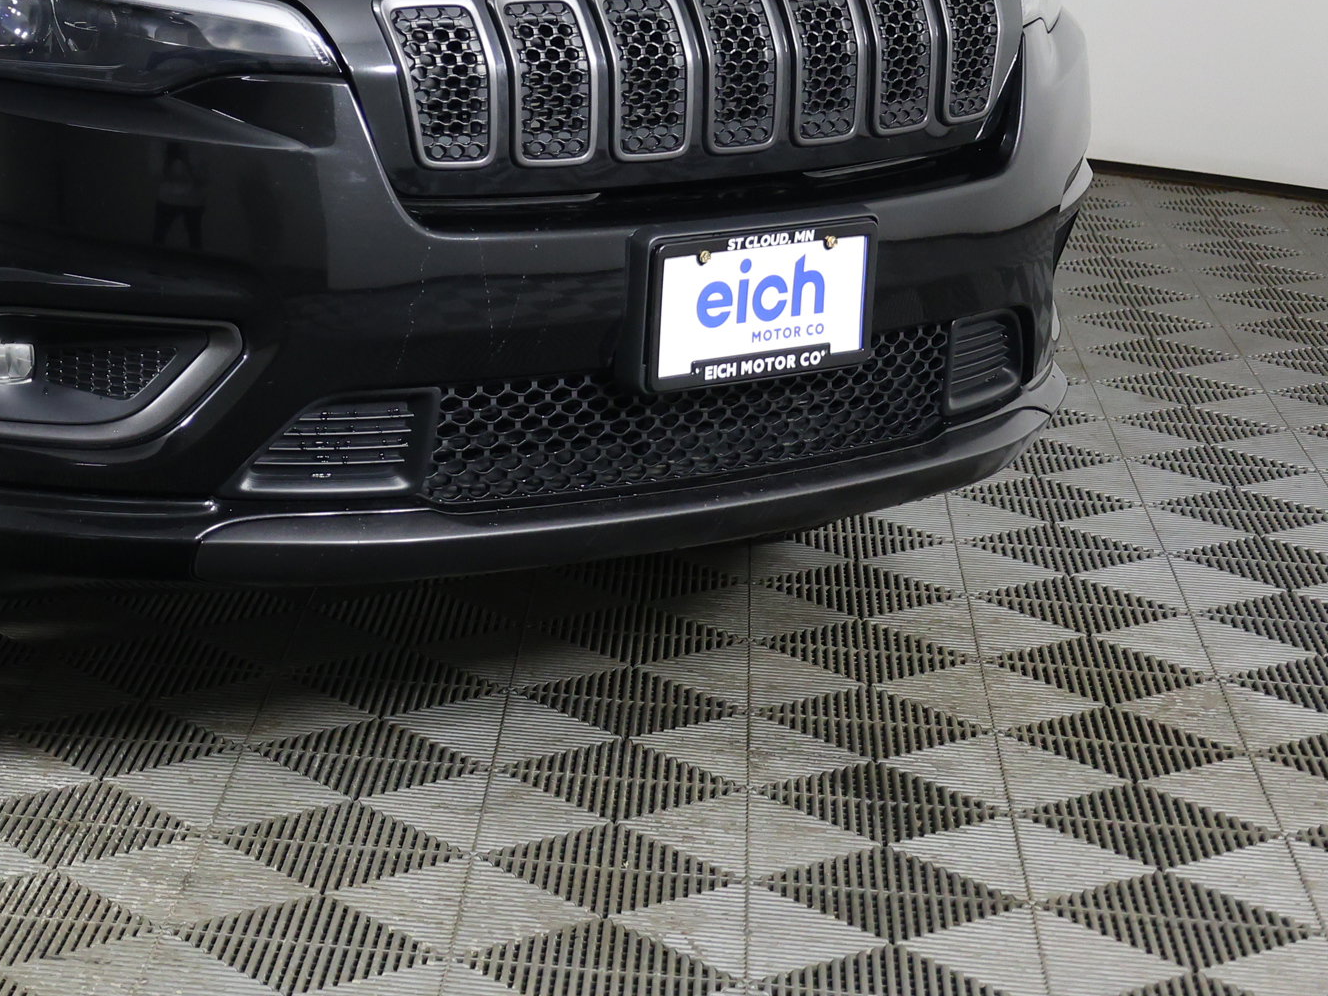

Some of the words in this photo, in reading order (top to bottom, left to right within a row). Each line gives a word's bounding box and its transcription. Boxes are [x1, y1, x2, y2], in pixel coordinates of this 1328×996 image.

[727, 237, 745, 251] ST
[745, 233, 792, 249] CLOUD,
[794, 229, 815, 243] MN
[696, 254, 826, 329] eich
[751, 325, 801, 343] MOTOR
[806, 322, 825, 336] CO
[704, 362, 737, 381] EICH
[740, 354, 796, 376] MOTOR
